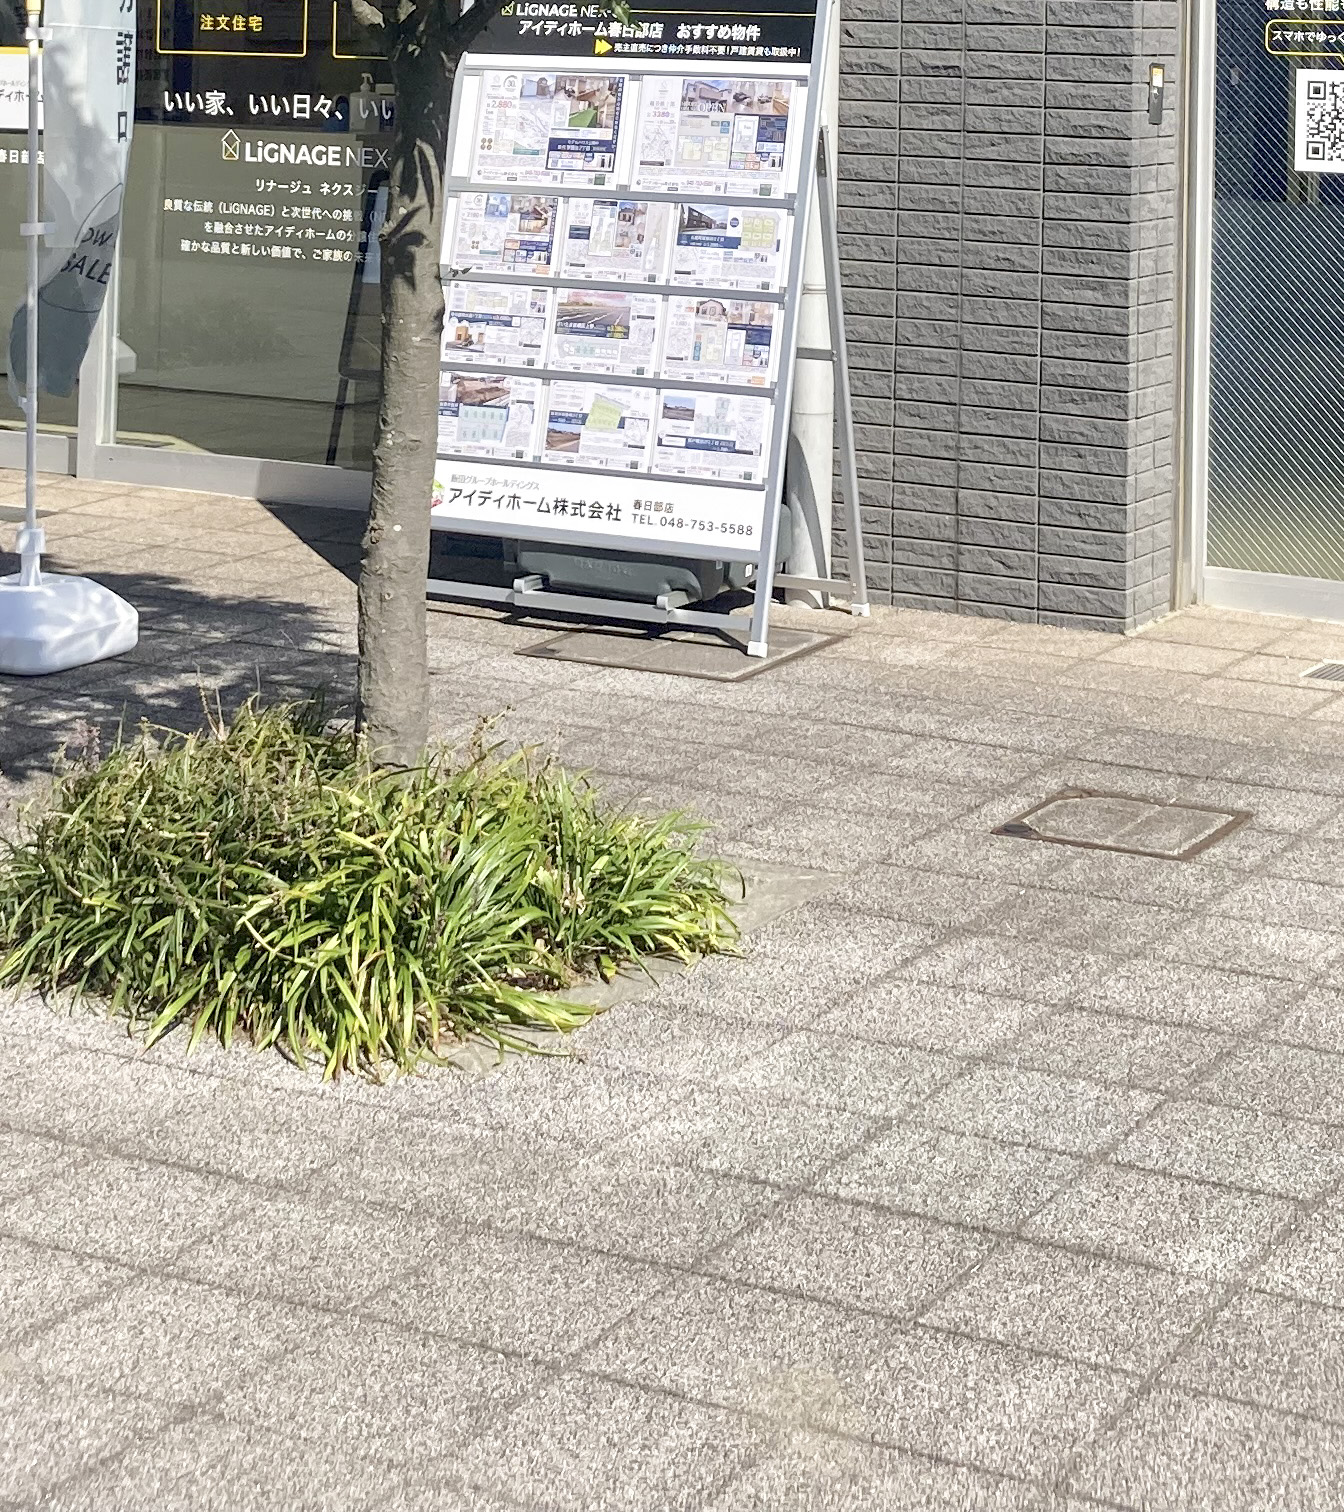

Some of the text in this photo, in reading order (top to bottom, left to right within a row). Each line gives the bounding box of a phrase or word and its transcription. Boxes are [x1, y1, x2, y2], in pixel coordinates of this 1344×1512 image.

[515, 2, 577, 17] LiGNAGE
[199, 14, 263, 32] 注文住宅
[677, 22, 761, 42] おすすめ物件
[244, 140, 392, 169] LiGNAGE NEX-
[255, 178, 312, 194] リナージュ
[448, 487, 623, 522] アイディホーム株式会社
[632, 499, 675, 514] 春日部店
